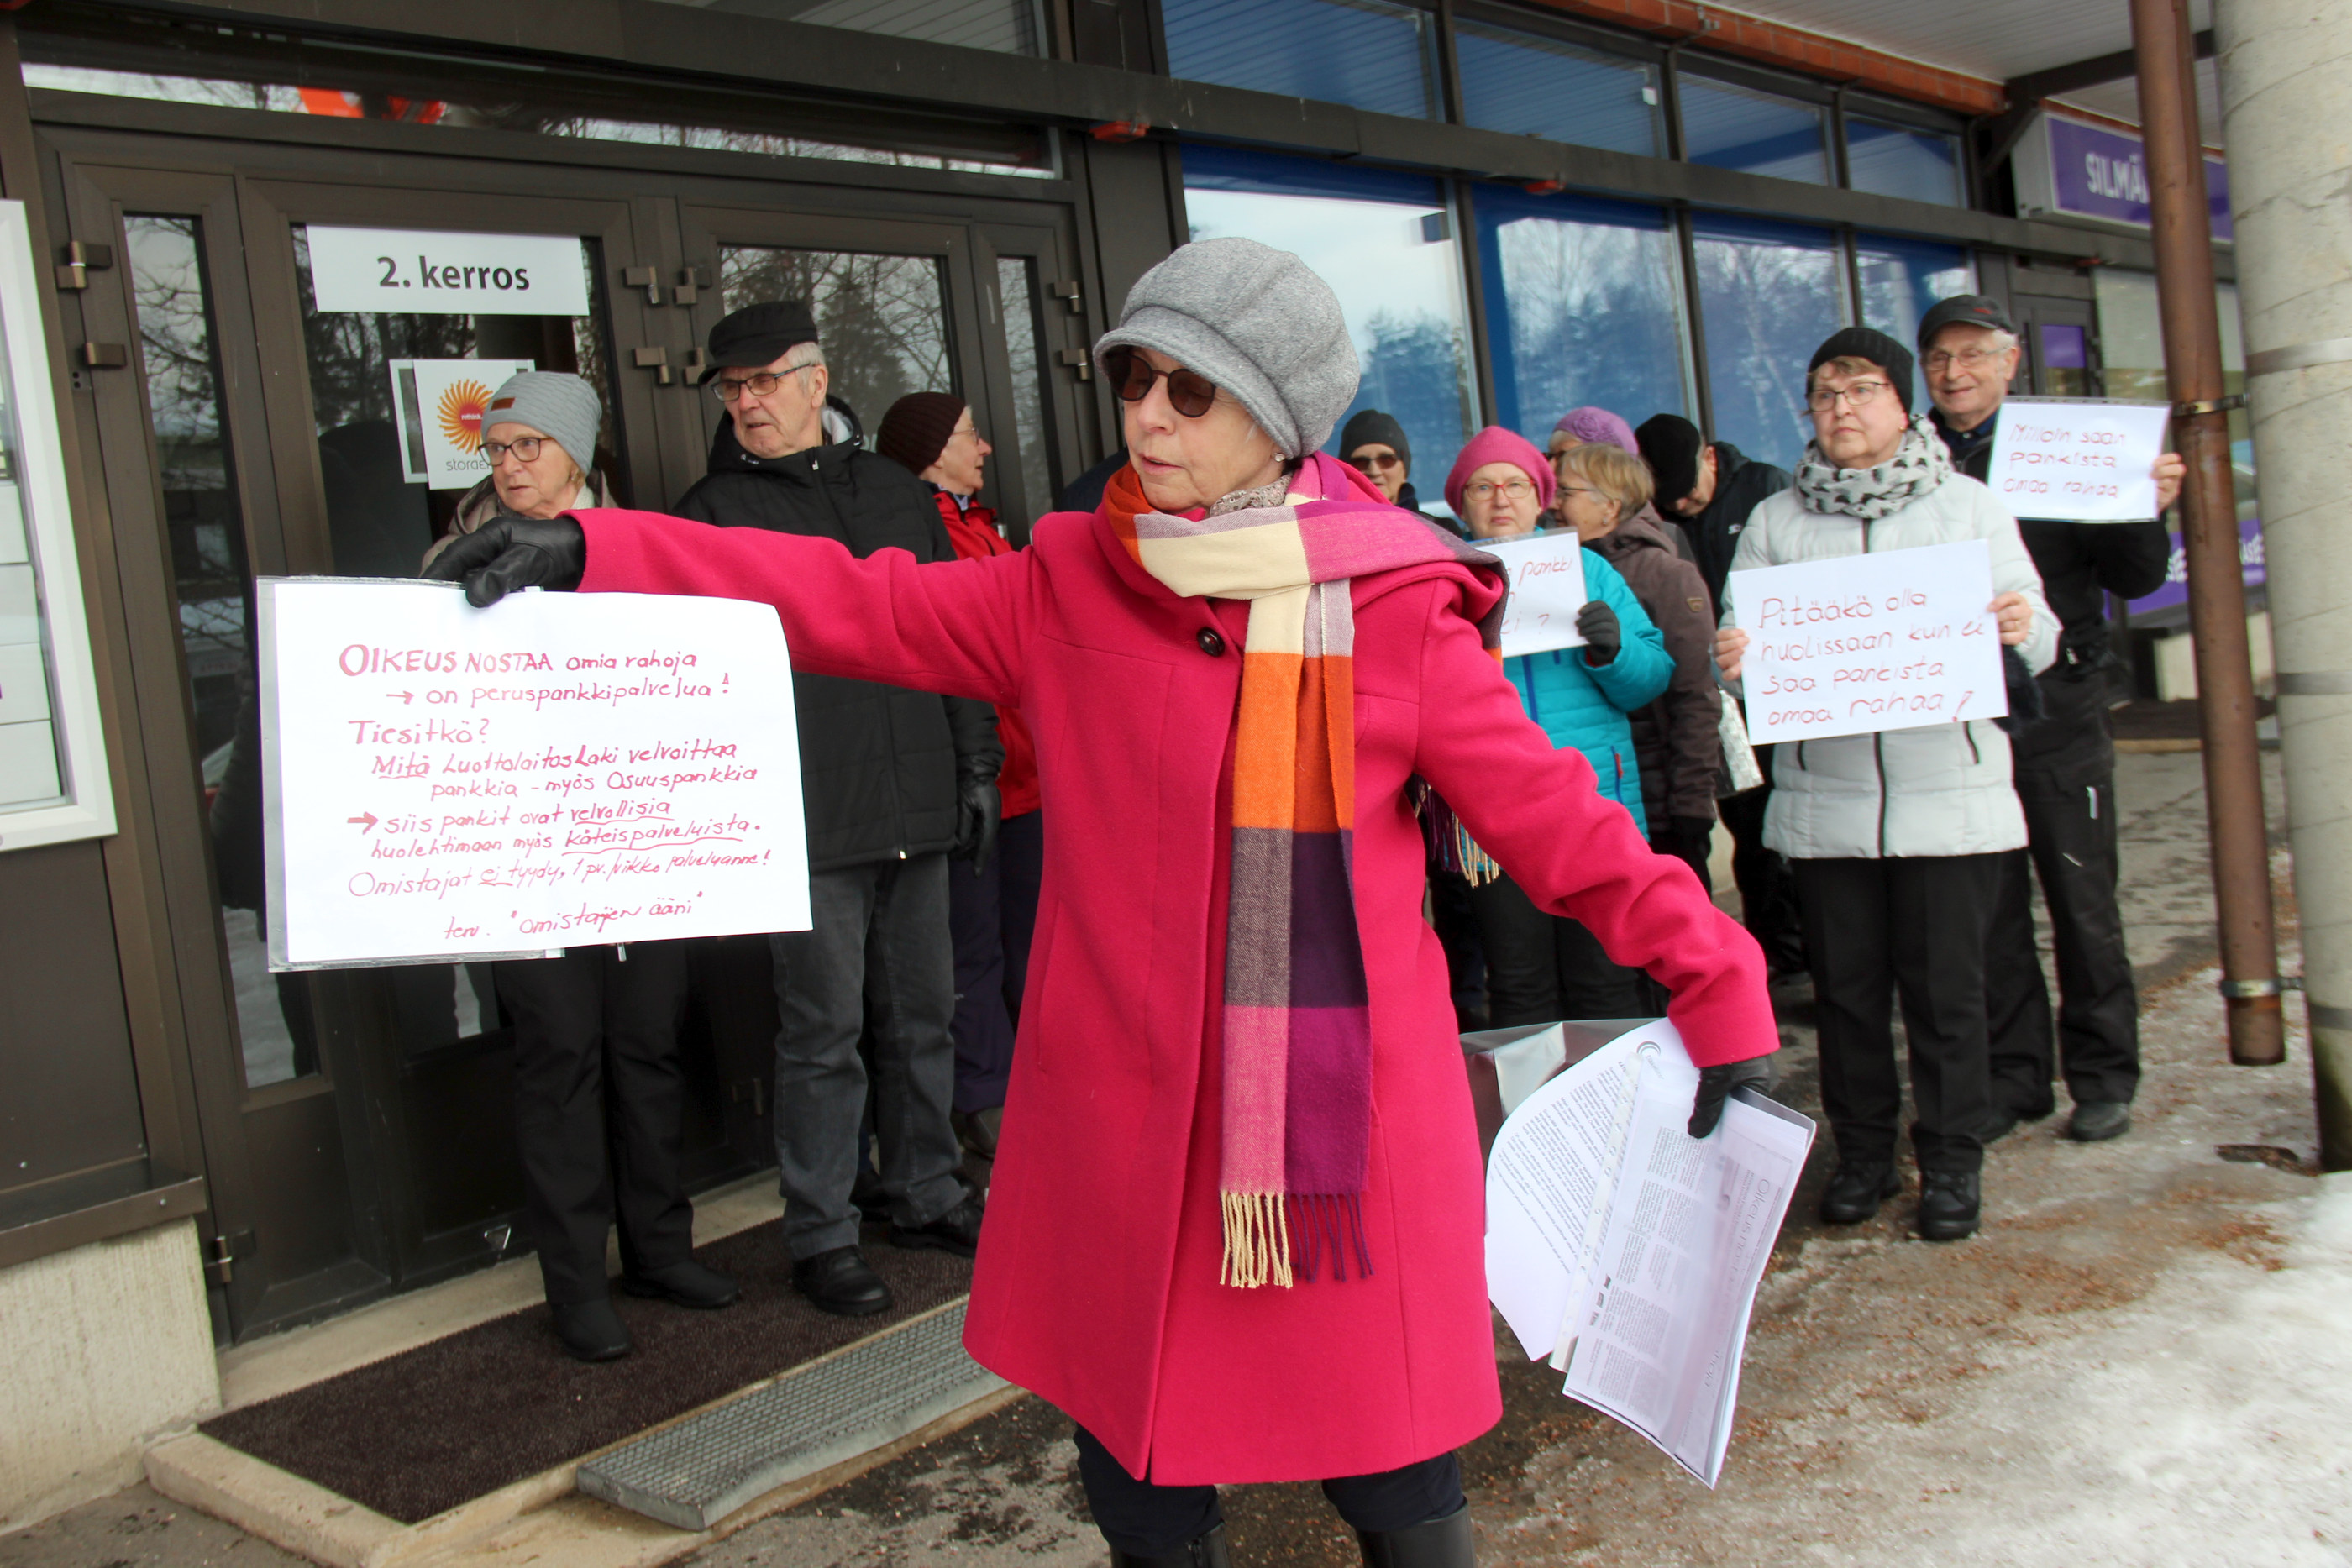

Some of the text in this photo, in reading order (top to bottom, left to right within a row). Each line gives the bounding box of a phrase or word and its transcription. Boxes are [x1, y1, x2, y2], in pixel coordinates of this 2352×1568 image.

[376, 255, 530, 291] 2. kerros
[2079, 431, 2127, 447] saan
[2008, 450, 2117, 470] pankista
[2003, 478, 2119, 499] omaa rahaa
[1758, 588, 1928, 629] Pitääkö olla
[1761, 630, 1893, 662] huolissaan
[1908, 622, 1951, 642] kun
[339, 643, 697, 677] OIKEUS NOSTAA omia rahoja
[1833, 655, 1945, 690] pankista
[426, 690, 458, 705] on
[1767, 705, 1834, 726] omaa
[371, 751, 431, 776] Mitä
[628, 738, 737, 764] velvoittaa
[430, 778, 518, 802] pankkia
[606, 764, 758, 793] Osuuspankkia
[384, 797, 672, 836] siis pankit ovat velvollisia
[370, 835, 503, 859] huolehtimaan
[512, 831, 553, 858] myös
[348, 866, 472, 901] Omistajat
[480, 866, 501, 882] ei
[508, 858, 565, 889] tyydy,
